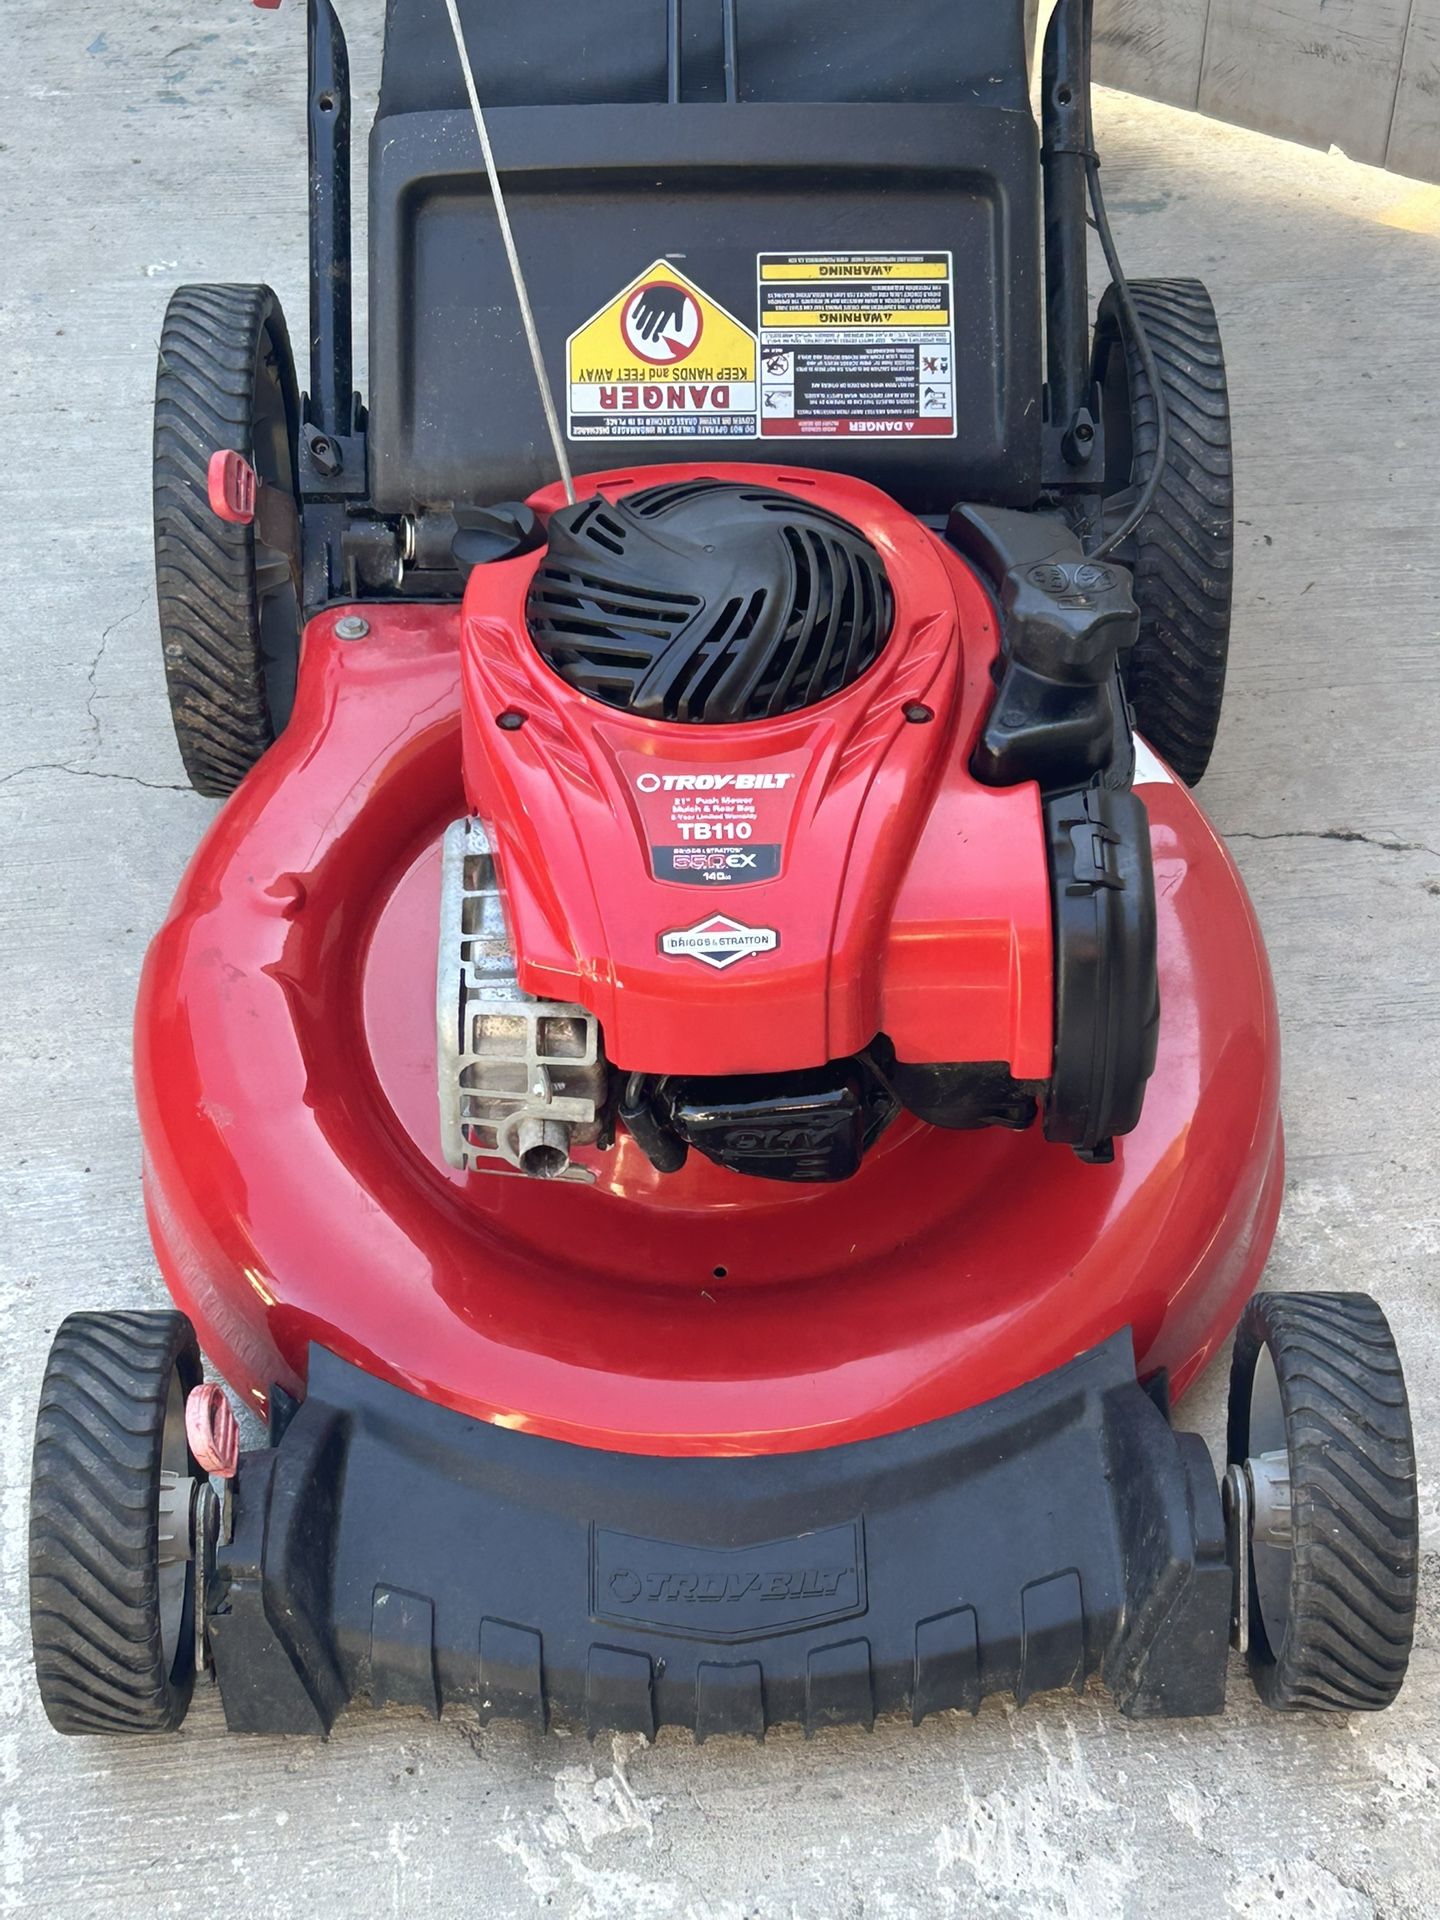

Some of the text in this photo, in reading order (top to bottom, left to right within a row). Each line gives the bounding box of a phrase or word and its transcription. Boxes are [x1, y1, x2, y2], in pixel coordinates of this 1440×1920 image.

[819, 265, 883, 275] WARNING
[819, 313, 883, 323] WARNING
[578, 368, 747, 381] KEEP HANDS and FEET AWAY
[599, 386, 730, 409] DANGER
[698, 426, 728, 434] OPERATE
[730, 426, 744, 434] NOT
[745, 426, 755, 434] DO
[849, 421, 903, 432] DANGER
[661, 773, 791, 790] TROY-BILT
[736, 805, 756, 813] Bag
[677, 822, 752, 840] TB110
[647, 1568, 848, 1602] TROY-BILT
